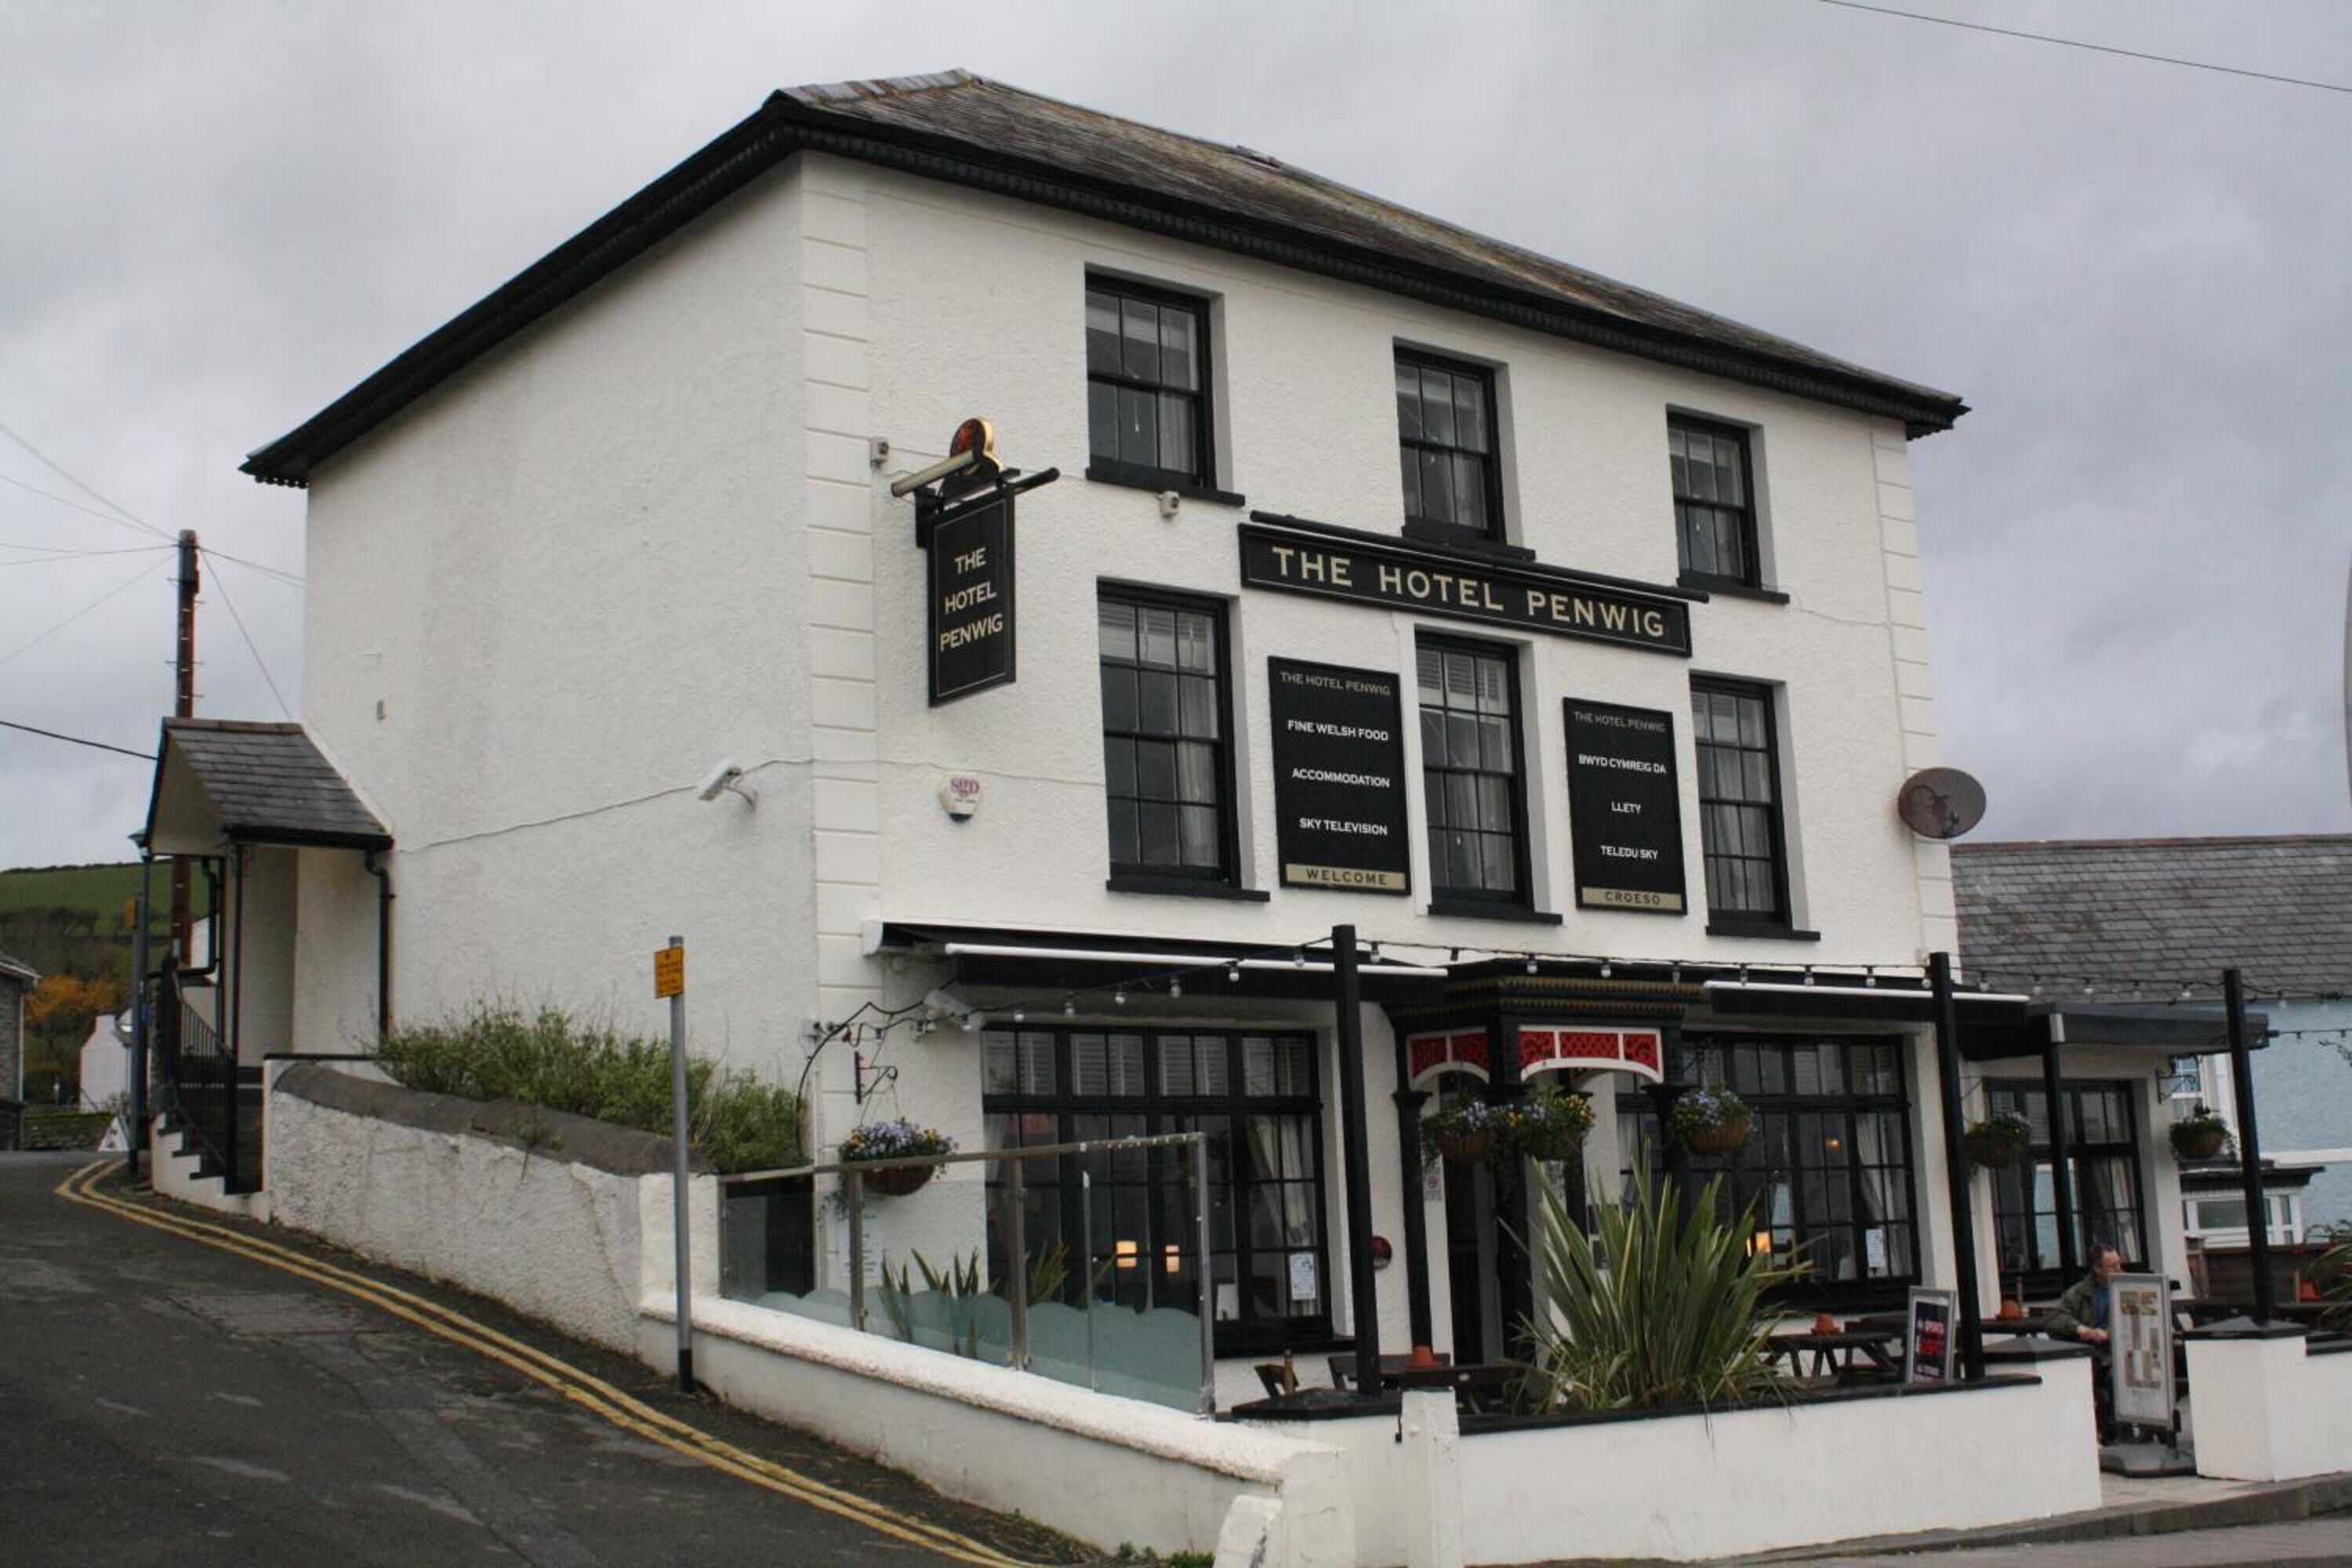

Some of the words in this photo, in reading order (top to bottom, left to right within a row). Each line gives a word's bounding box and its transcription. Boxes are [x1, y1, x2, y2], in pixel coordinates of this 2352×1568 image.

[954, 546, 986, 574] THE
[944, 581, 997, 615] HOTEL
[1272, 546, 1352, 587] THE
[1379, 564, 1504, 612] HOTEL
[1526, 590, 1665, 637] PENWIG
[939, 612, 1004, 652] PENWIG
[1279, 672, 1304, 684] THE
[1305, 676, 1343, 690] HOTEL
[1345, 680, 1391, 696] PENWIG
[1573, 711, 1594, 723] THE
[1595, 714, 1627, 727] HOTEL
[1287, 719, 1314, 732] FINE
[1316, 723, 1356, 737] WELSH
[1358, 728, 1389, 741] FOOD
[1578, 753, 1608, 768] BWYD
[1609, 757, 1651, 772] CYMREIG
[1653, 762, 1667, 774] DA
[1292, 768, 1390, 788] ACCOMMODATION
[1611, 801, 1641, 814] LLETY
[1299, 818, 1322, 829] SKY
[1323, 819, 1388, 836] TELEVISION
[1600, 845, 1638, 858] TELEDU
[1640, 849, 1658, 860] SKY
[1306, 868, 1387, 885] WELCOME
[1605, 891, 1661, 906] CROESO
